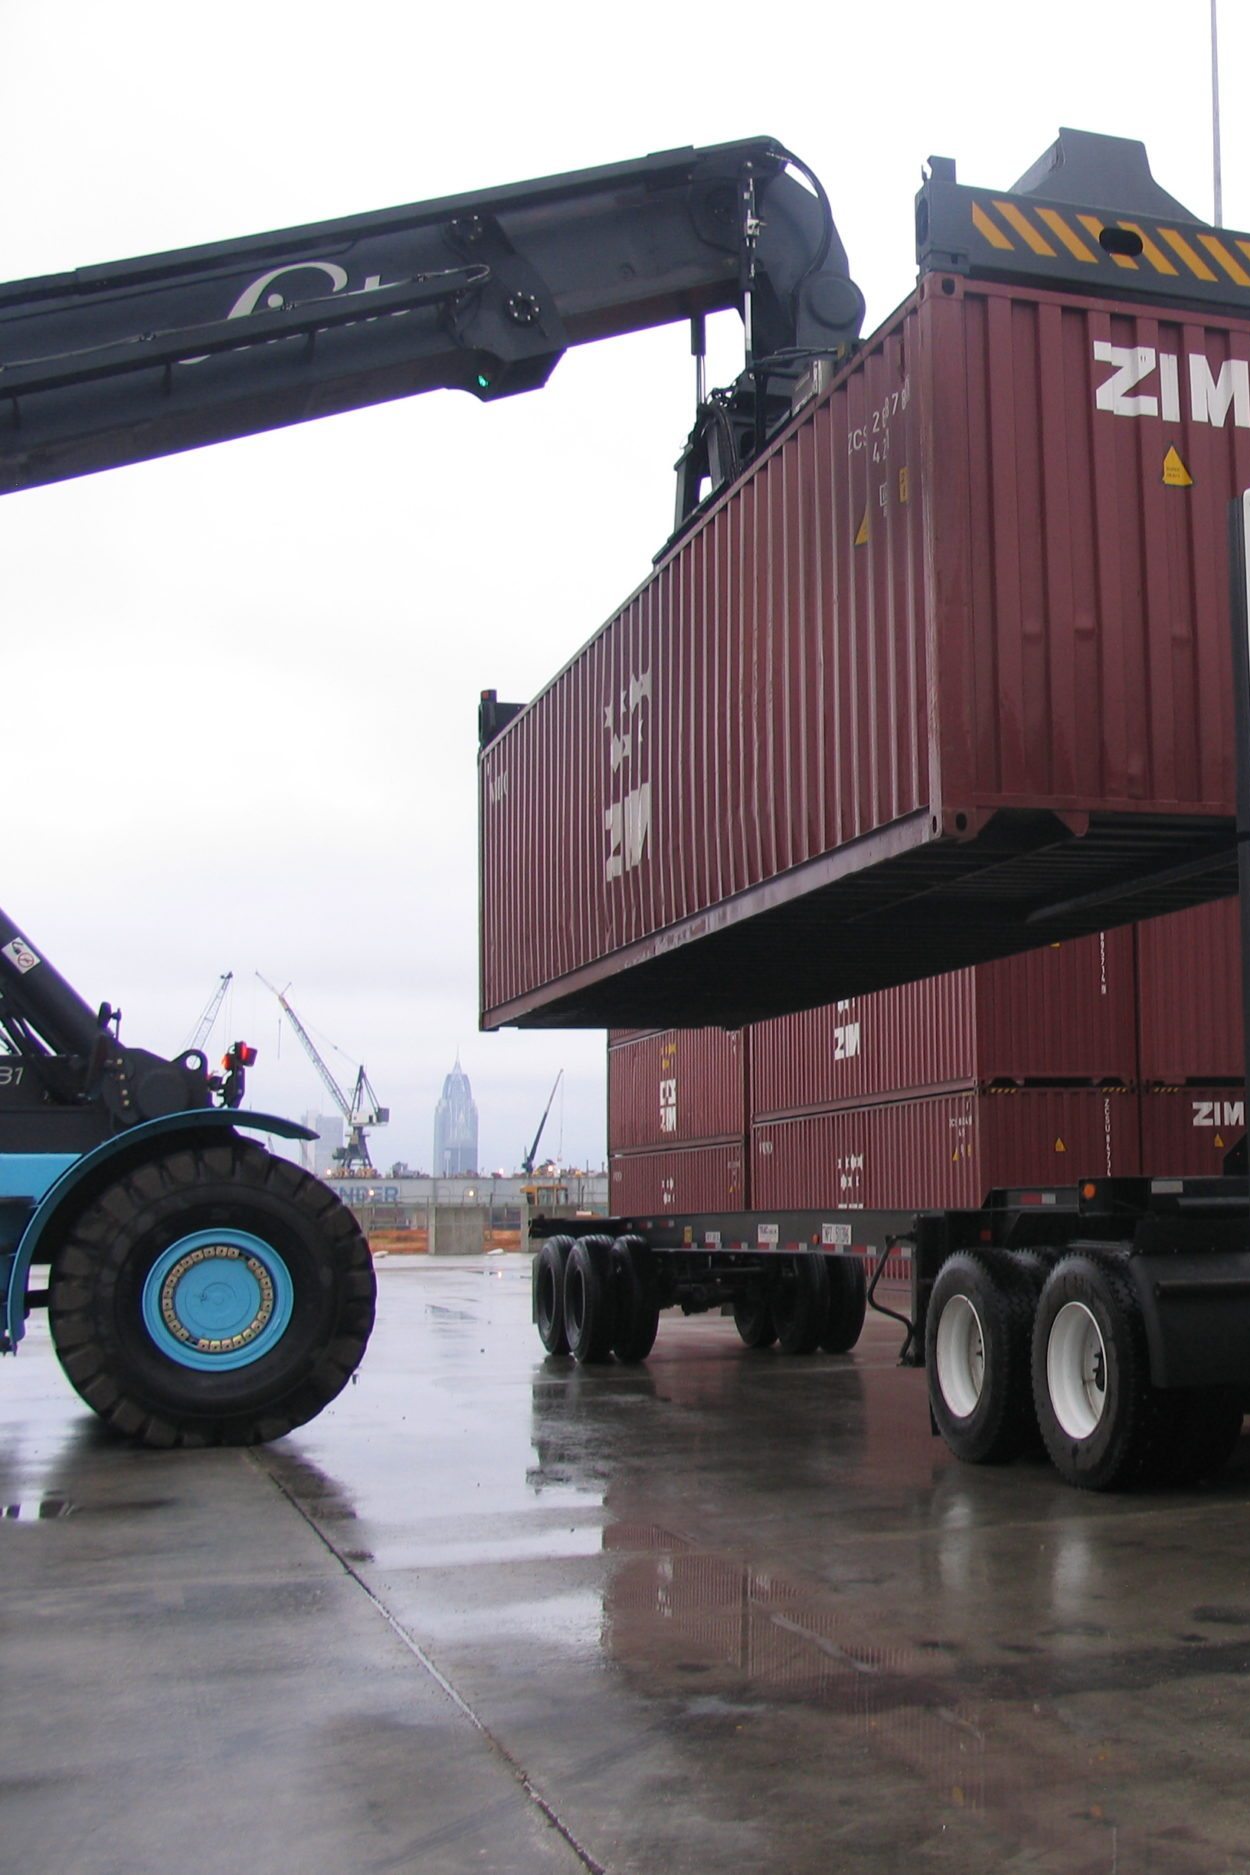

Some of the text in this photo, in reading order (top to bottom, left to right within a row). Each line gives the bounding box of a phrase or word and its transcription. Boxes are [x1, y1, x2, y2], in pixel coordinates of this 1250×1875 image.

[605, 782, 651, 882] ZIM
[834, 1022, 860, 1060] ZIM
[1192, 1101, 1245, 1127] ZIM
